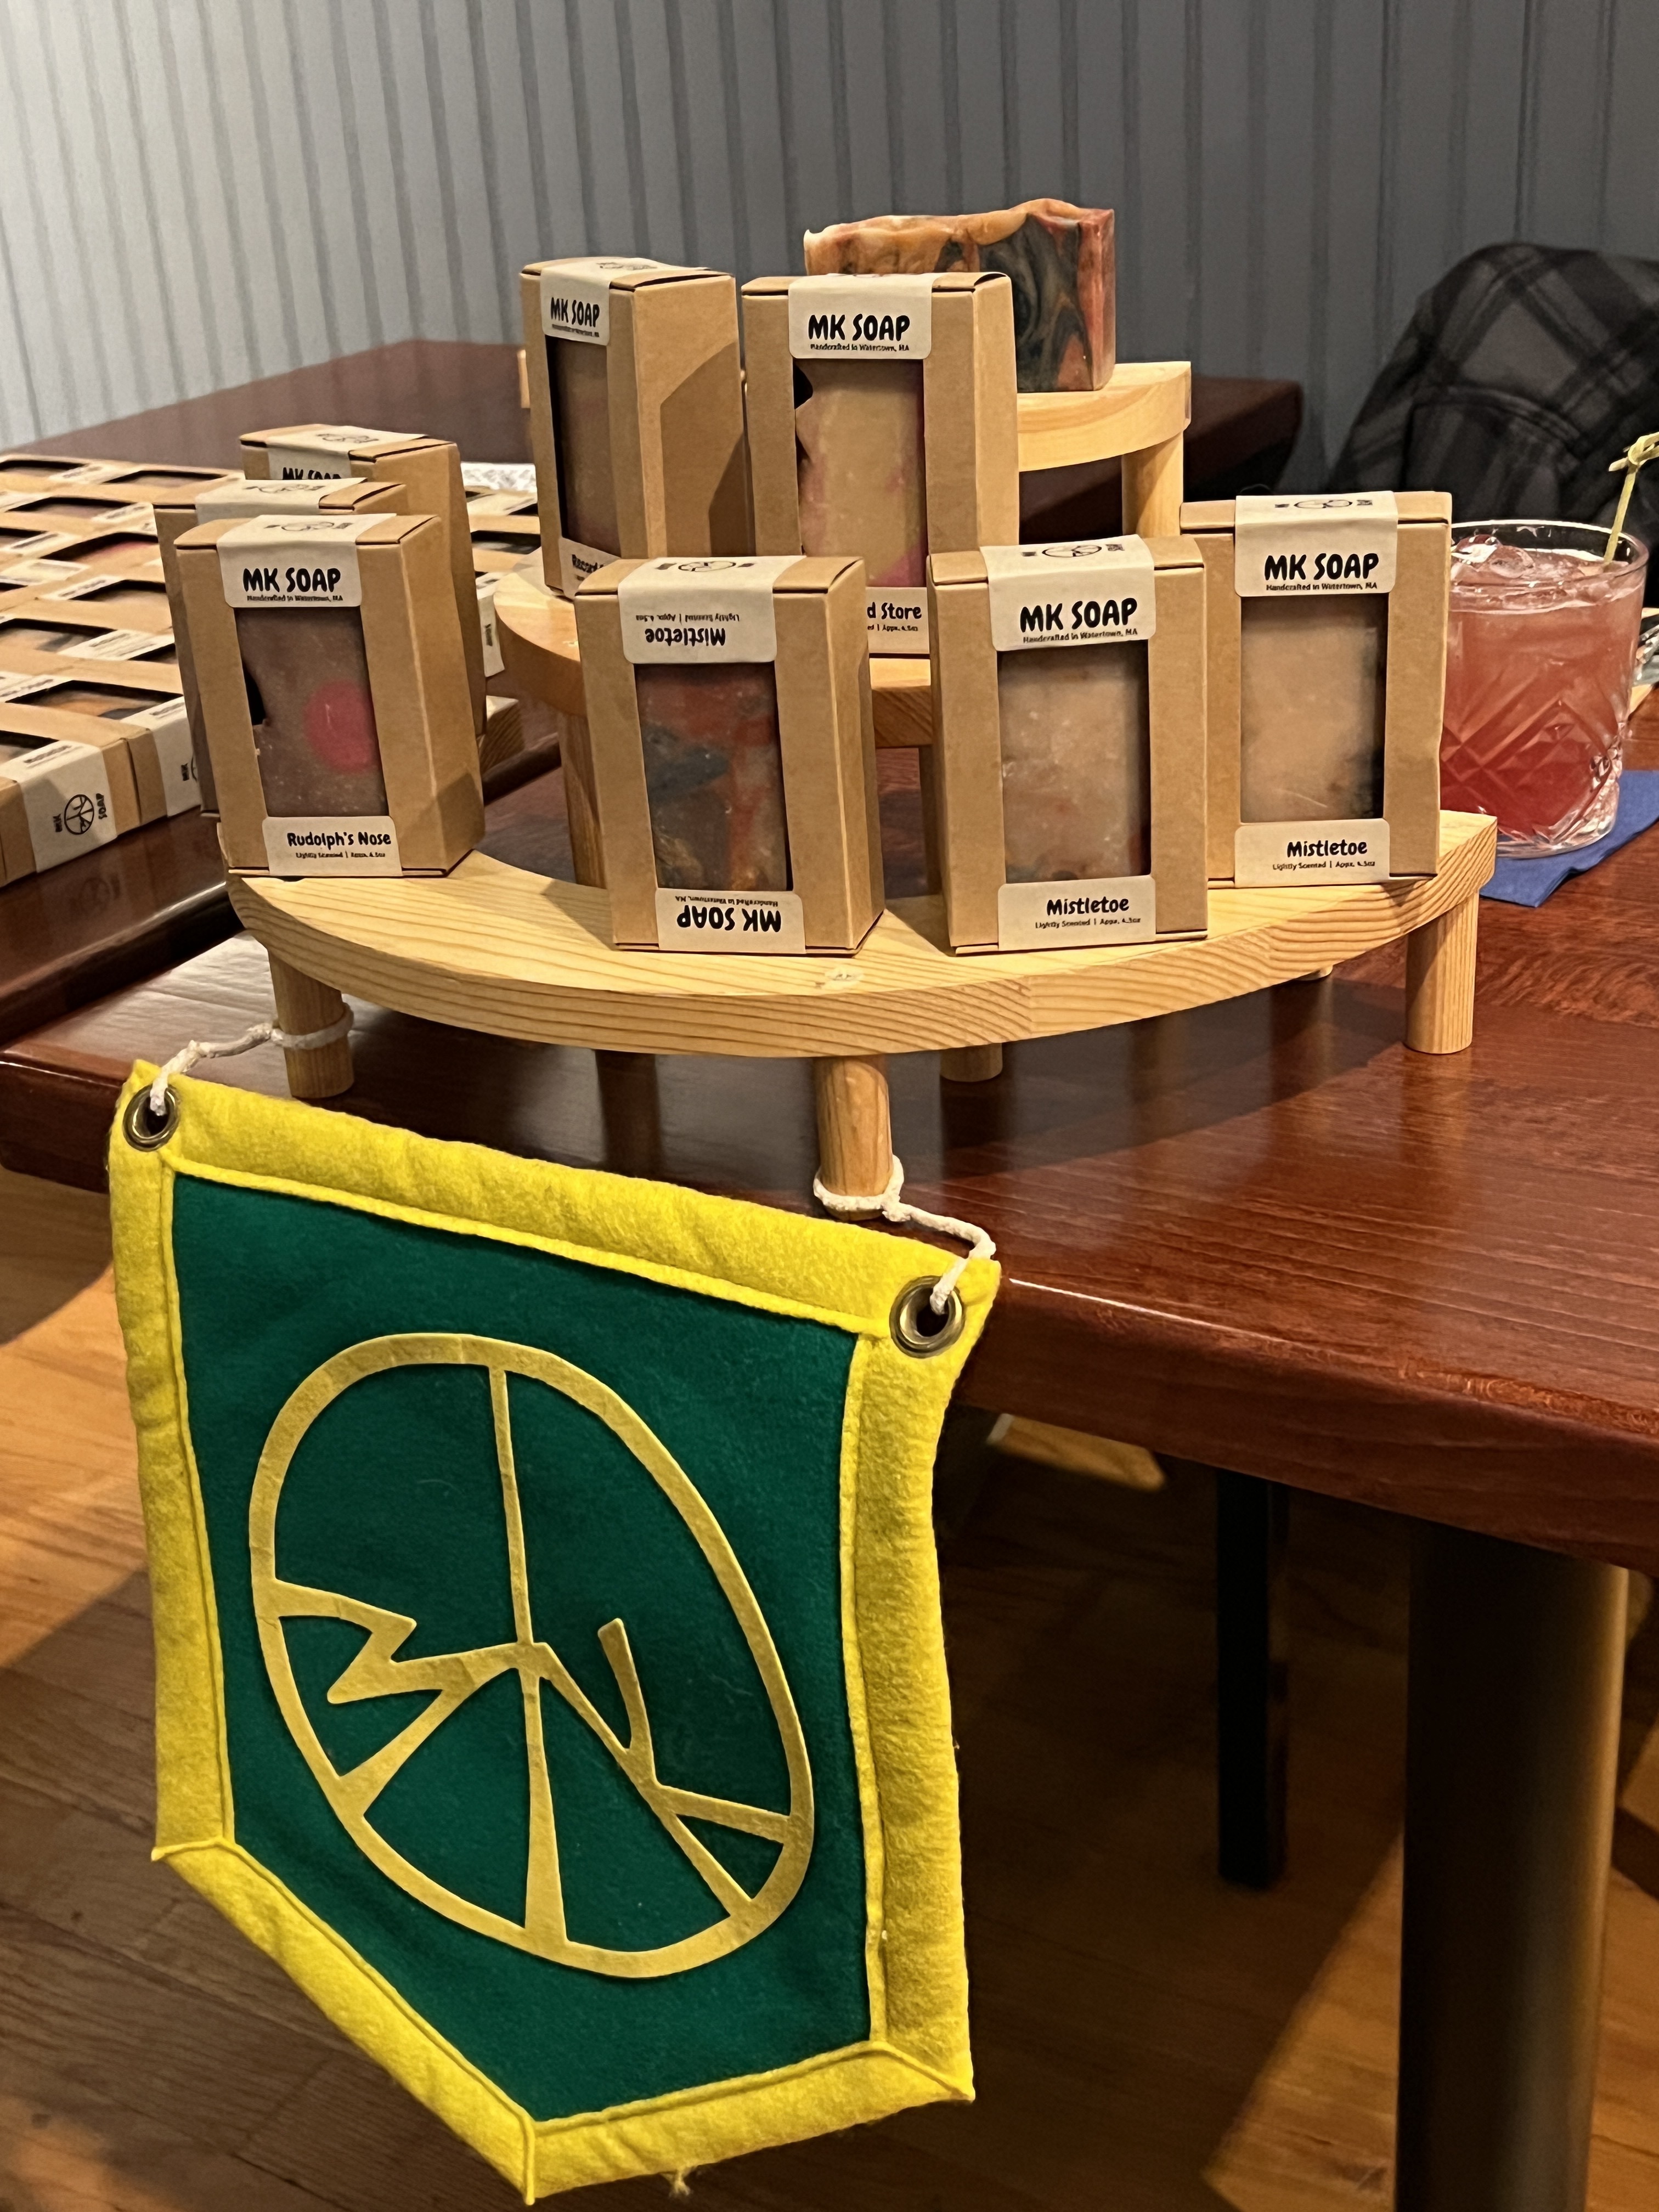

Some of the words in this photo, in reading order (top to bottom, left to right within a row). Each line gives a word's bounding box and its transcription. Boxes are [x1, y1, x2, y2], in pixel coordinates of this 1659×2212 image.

[550, 297, 569, 323] MK
[572, 300, 600, 328] SOAP
[808, 314, 845, 340] MK
[852, 313, 910, 341] SOAP
[1265, 554, 1307, 580] MK
[1313, 553, 1379, 580] SOAP
[243, 568, 280, 592] MK
[285, 567, 341, 592] SOAP
[881, 602, 922, 619] Store
[1020, 603, 1063, 633] MK
[1071, 597, 1137, 630] SOAP
[645, 628, 725, 646] Mistletoe
[1023, 632, 1069, 643] Handcrafted
[287, 832, 354, 850] Rudolph's
[358, 832, 391, 845] Nose
[1286, 839, 1367, 857] Mistletoe
[676, 905, 735, 930] SOAP
[1046, 896, 1130, 916] Mistletoe
[742, 909, 781, 932] MK
